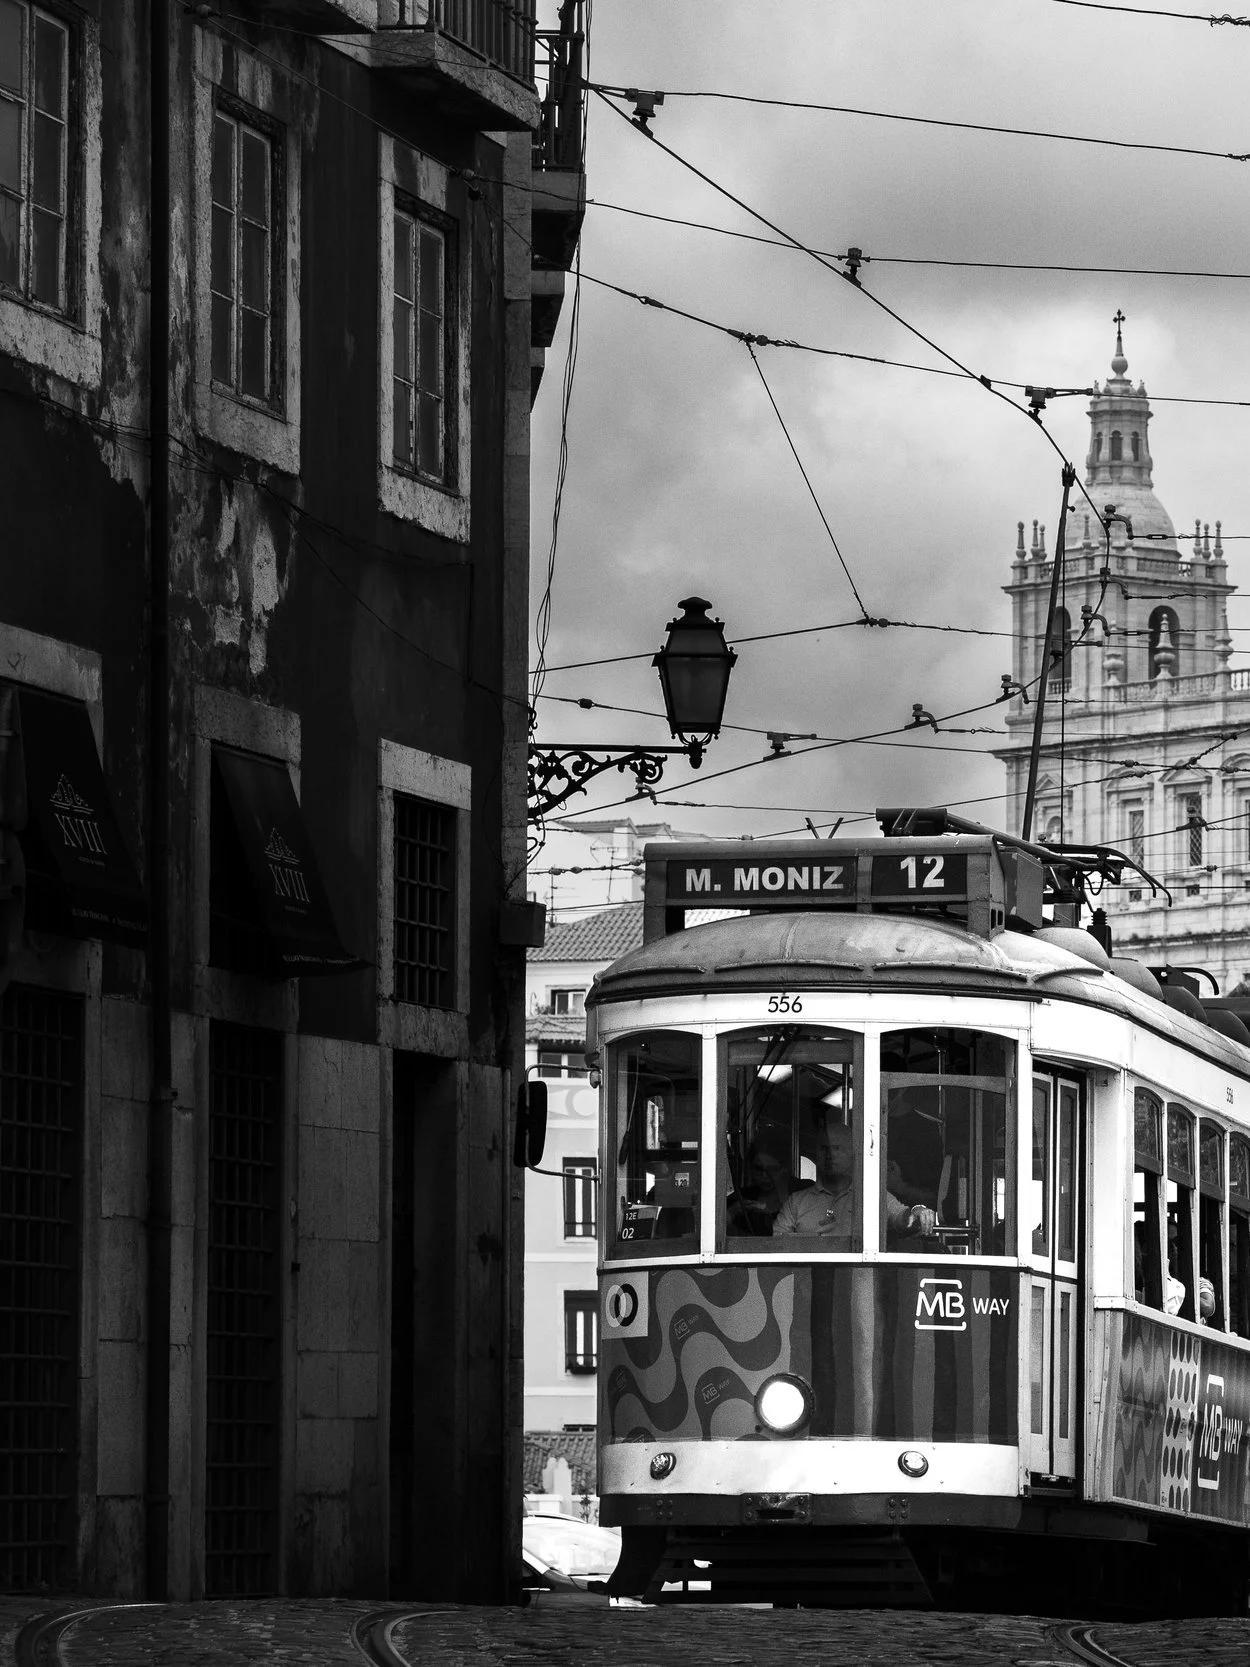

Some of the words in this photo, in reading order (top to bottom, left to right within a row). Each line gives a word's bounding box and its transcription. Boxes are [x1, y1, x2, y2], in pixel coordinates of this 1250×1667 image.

[54, 812, 108, 855] XVIII
[268, 863, 311, 903] XVIII
[686, 868, 722, 892] M.
[734, 866, 843, 891] MONIZ
[898, 856, 945, 889] 12
[767, 994, 803, 1014] 556
[625, 1212, 638, 1221] 12E
[621, 1227, 635, 1240] 02
[916, 1292, 966, 1319] MB
[972, 1296, 1010, 1316] WAY
[1199, 1402, 1223, 1462] MB
[1224, 1416, 1244, 1456] WAY
